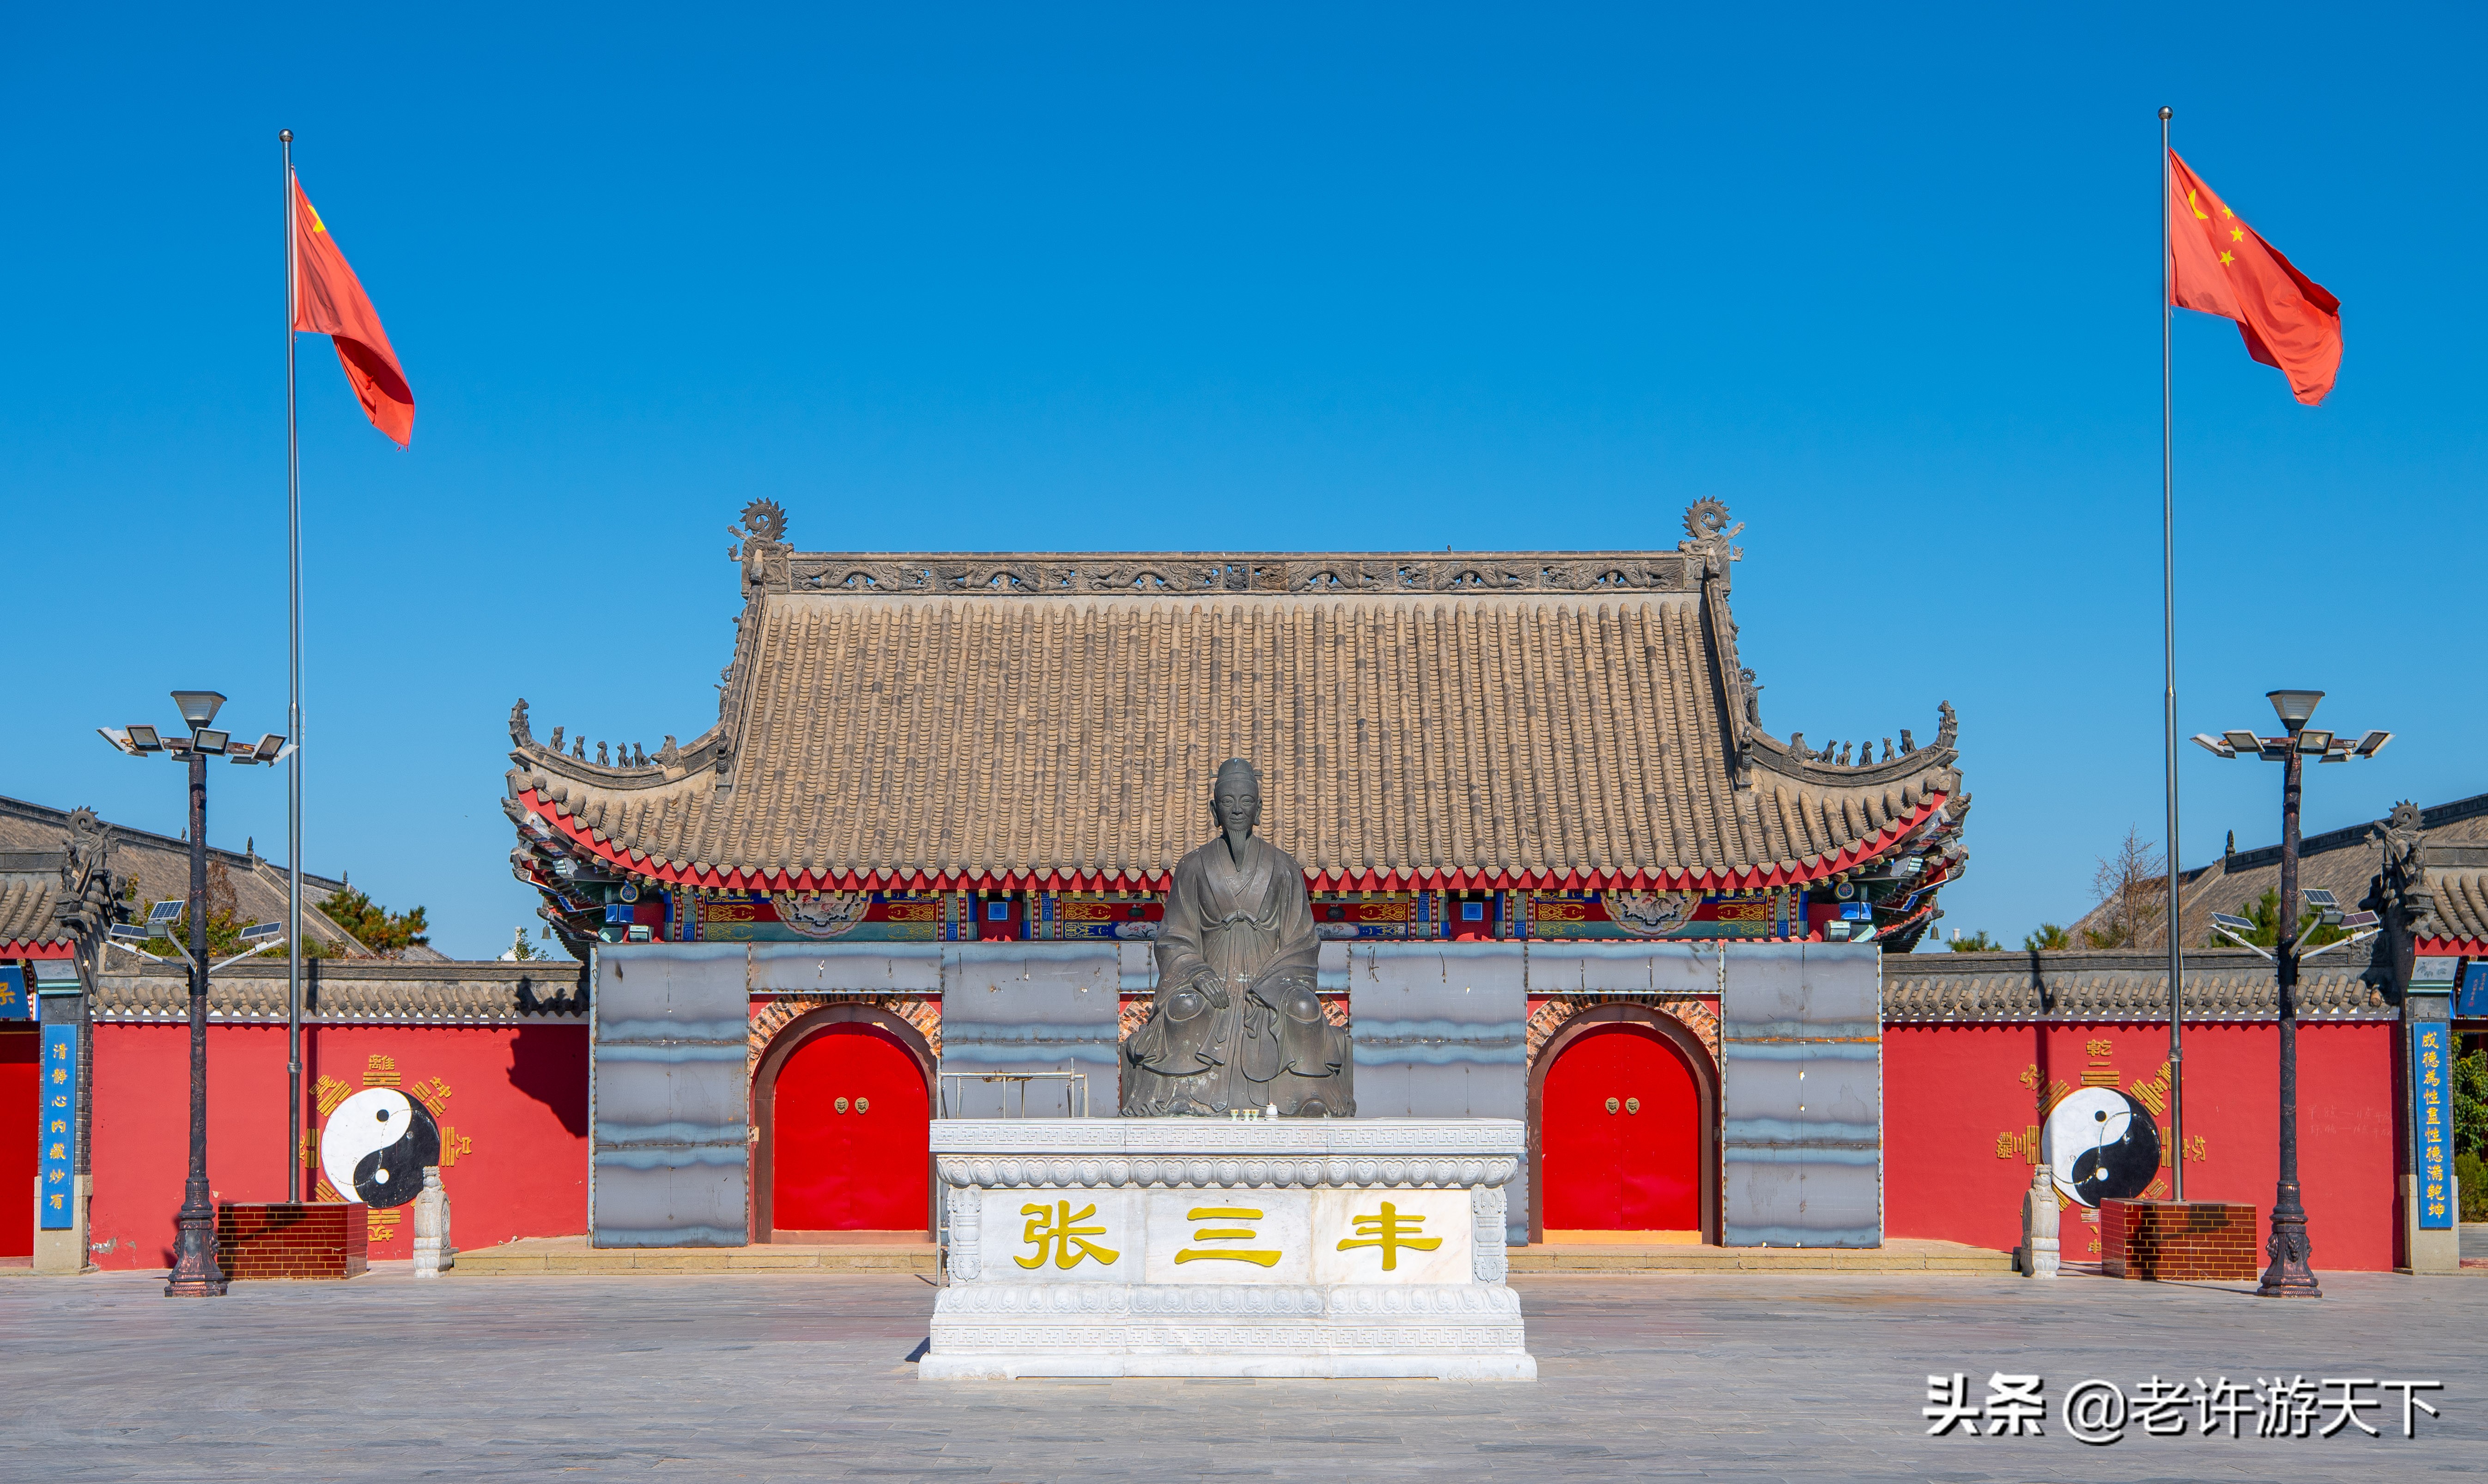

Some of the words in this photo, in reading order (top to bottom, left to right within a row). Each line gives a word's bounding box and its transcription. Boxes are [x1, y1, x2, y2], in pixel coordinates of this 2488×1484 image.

[430, 1076, 452, 1098] 坤
[1012, 1199, 1444, 1271] 张三丰
